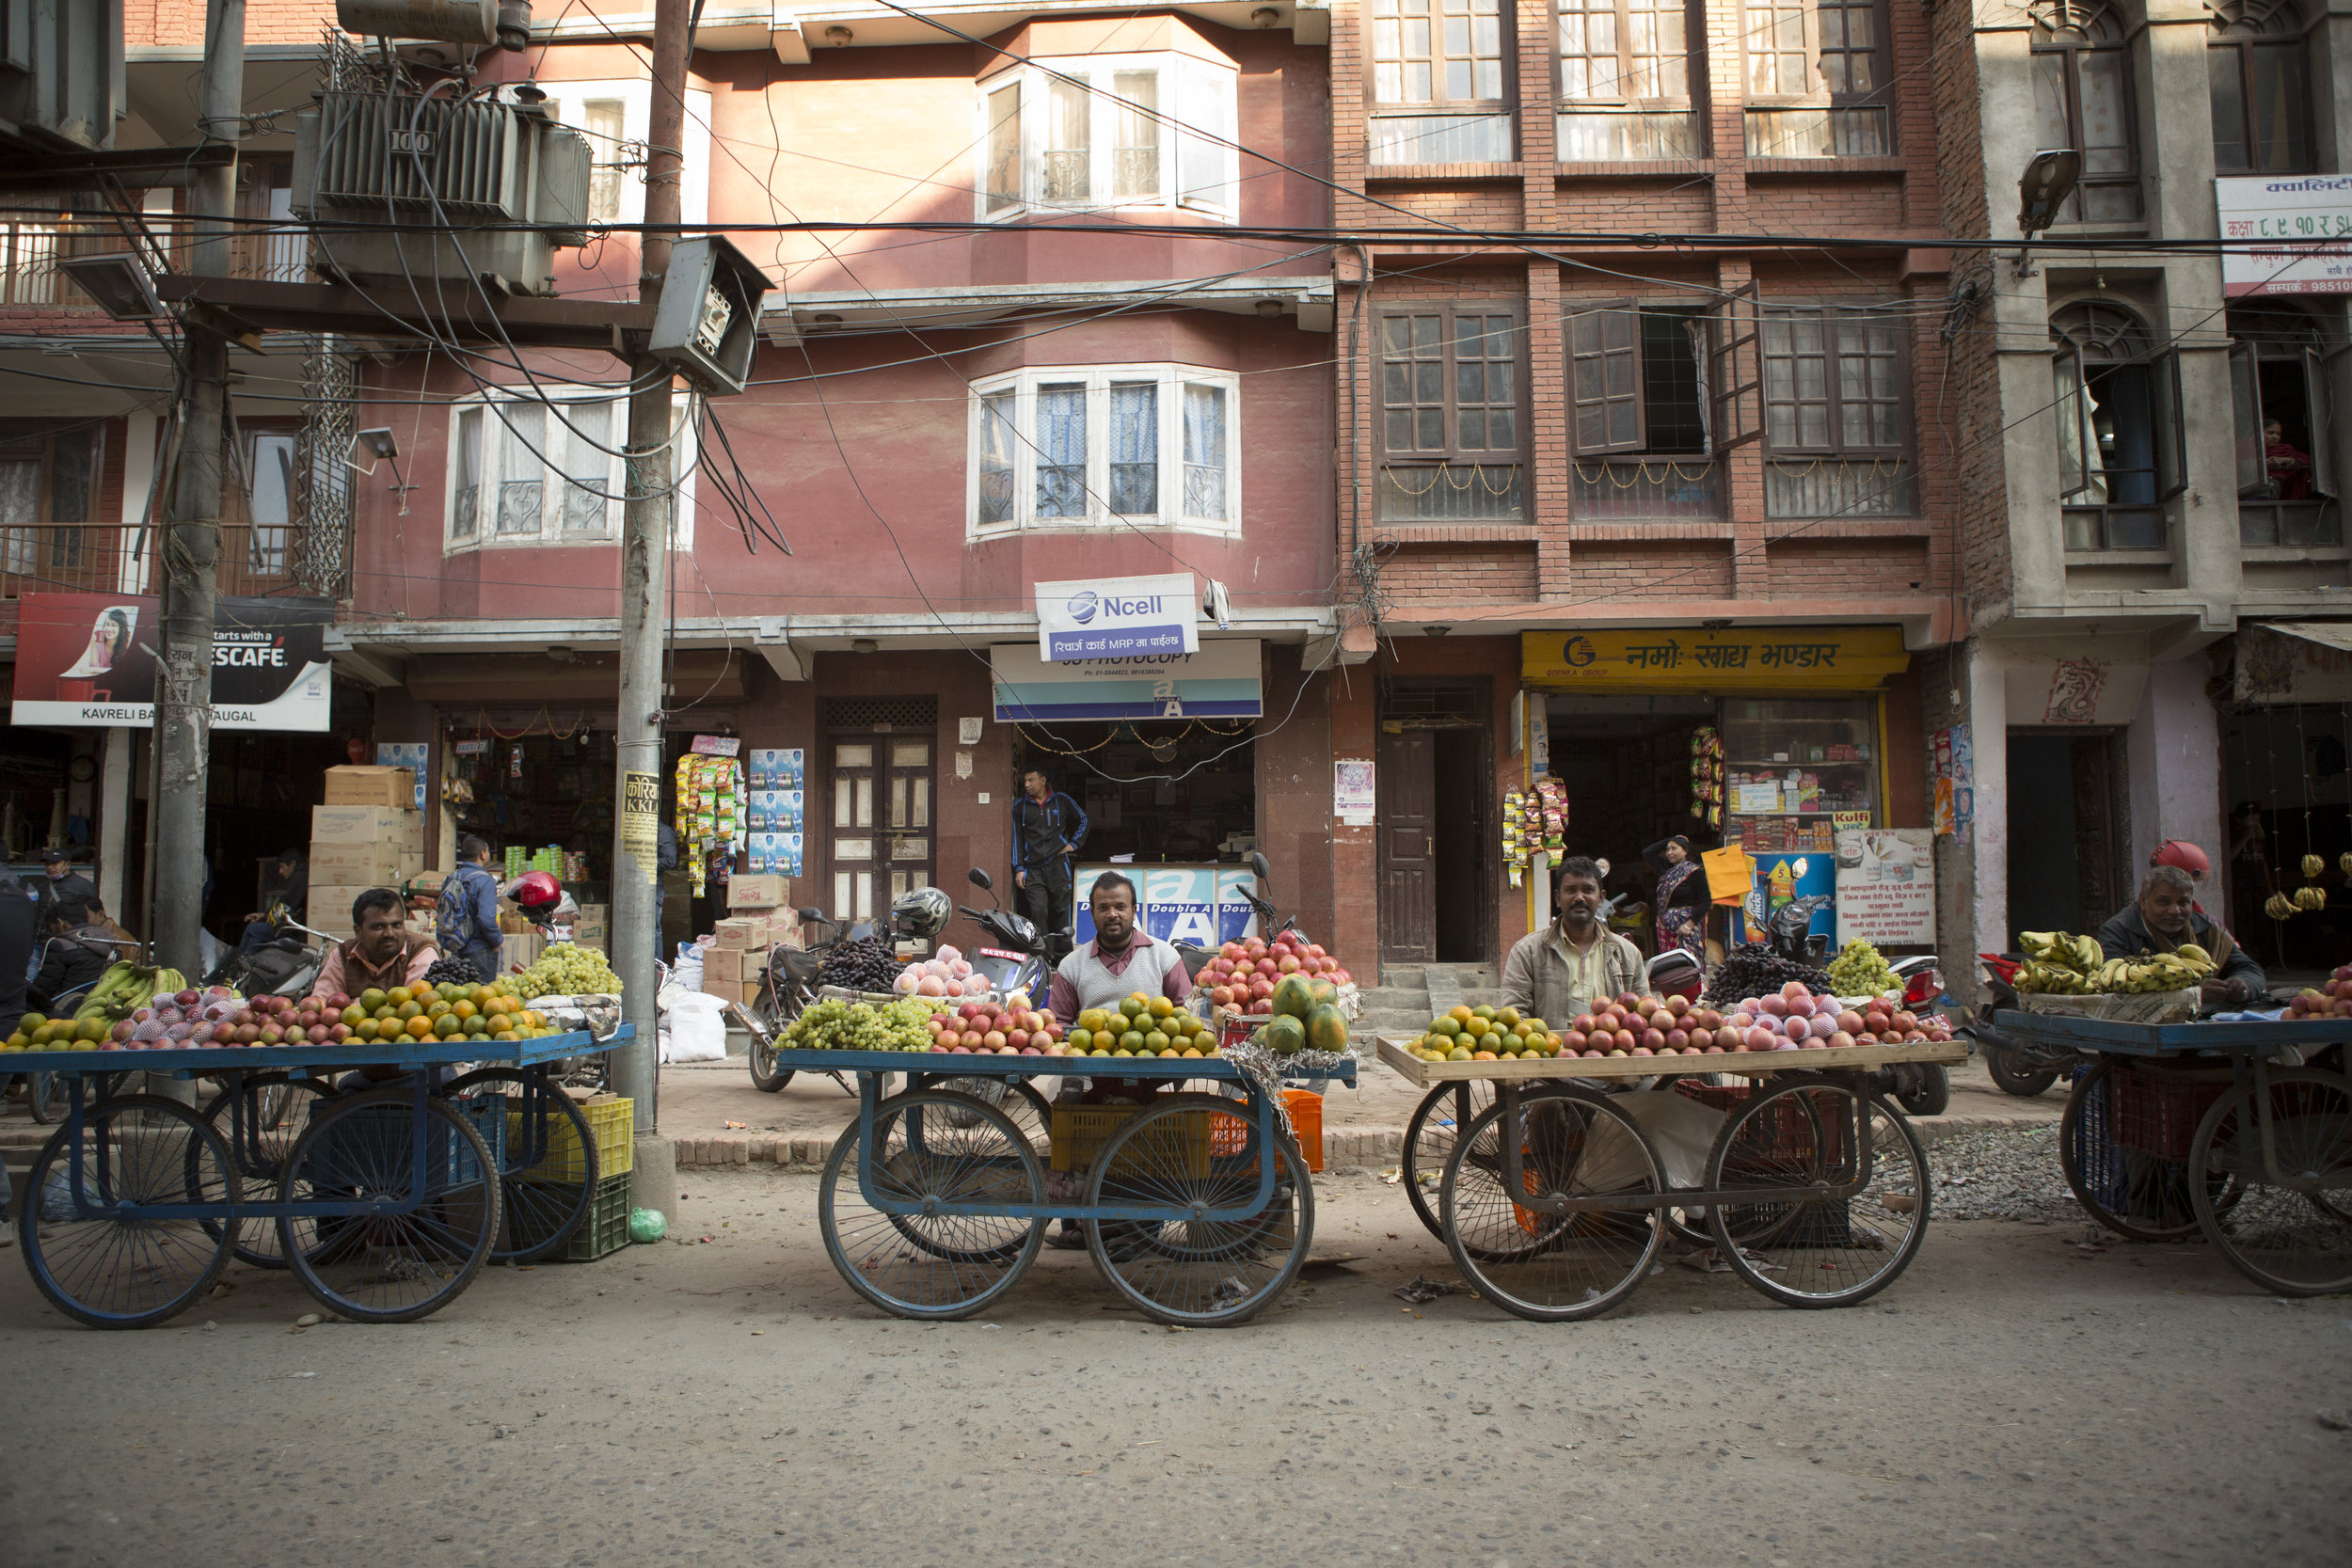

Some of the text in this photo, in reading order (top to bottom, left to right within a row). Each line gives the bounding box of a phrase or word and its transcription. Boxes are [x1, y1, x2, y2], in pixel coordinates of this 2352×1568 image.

[391, 132, 430, 150] 100
[2227, 220, 2254, 237] कक्षा
[2296, 216, 2314, 235] १०
[2319, 216, 2329, 235] र
[1104, 594, 1162, 617] Ncell
[214, 630, 272, 641] tarts with a
[1055, 638, 1083, 653] रिचार्ज
[1086, 638, 1105, 651] कार्ड
[1108, 639, 1134, 650] MRP
[1136, 638, 1148, 648] मा
[1760, 643, 1840, 668] भण्डार
[83, 707, 135, 720] KAVRELI
[139, 709, 155, 721] BA
[627, 799, 659, 813] KKL
[1835, 813, 1868, 822] Kulfi
[1778, 869, 1784, 879] 5
[1151, 905, 1211, 913] Double A
